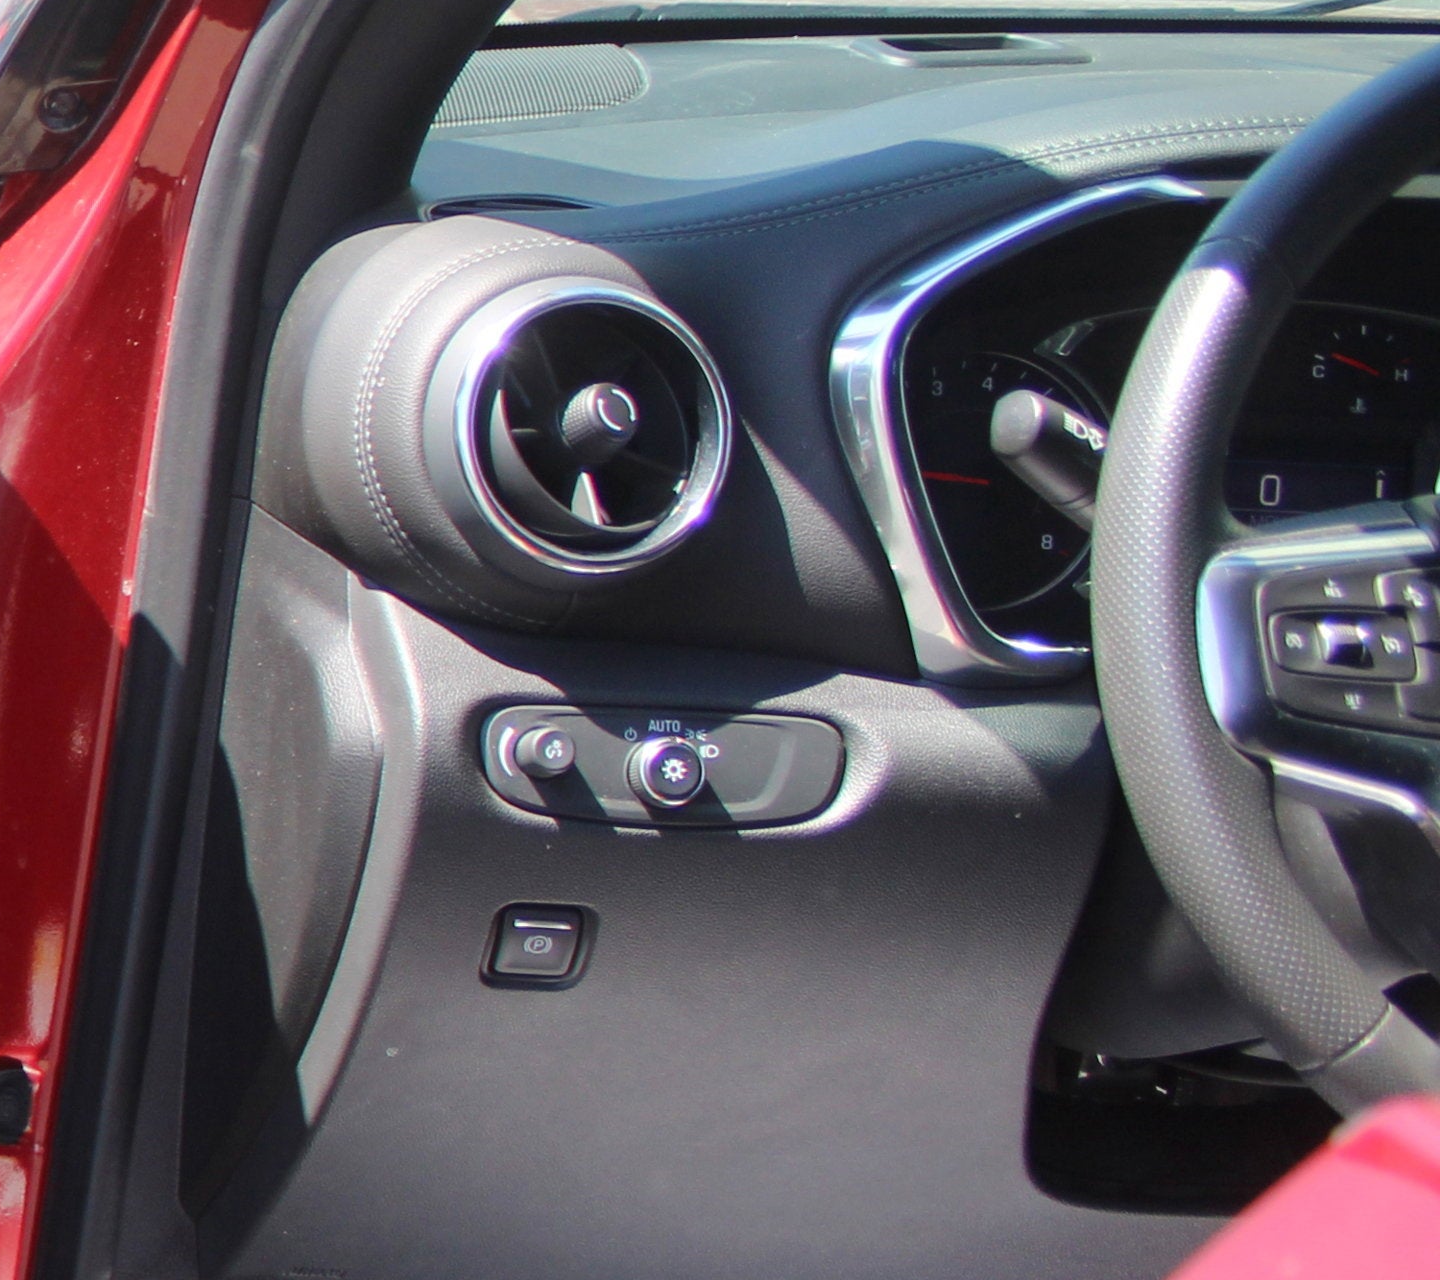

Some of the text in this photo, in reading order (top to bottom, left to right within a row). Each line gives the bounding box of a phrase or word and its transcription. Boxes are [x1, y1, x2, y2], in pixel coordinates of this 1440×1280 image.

[1312, 365, 1325, 378] C
[1394, 369, 1408, 381] H
[932, 380, 944, 396] 3
[982, 376, 994, 391] 4
[1259, 474, 1281, 506] 0
[1041, 534, 1053, 550] 8
[648, 719, 681, 732] AUTO
